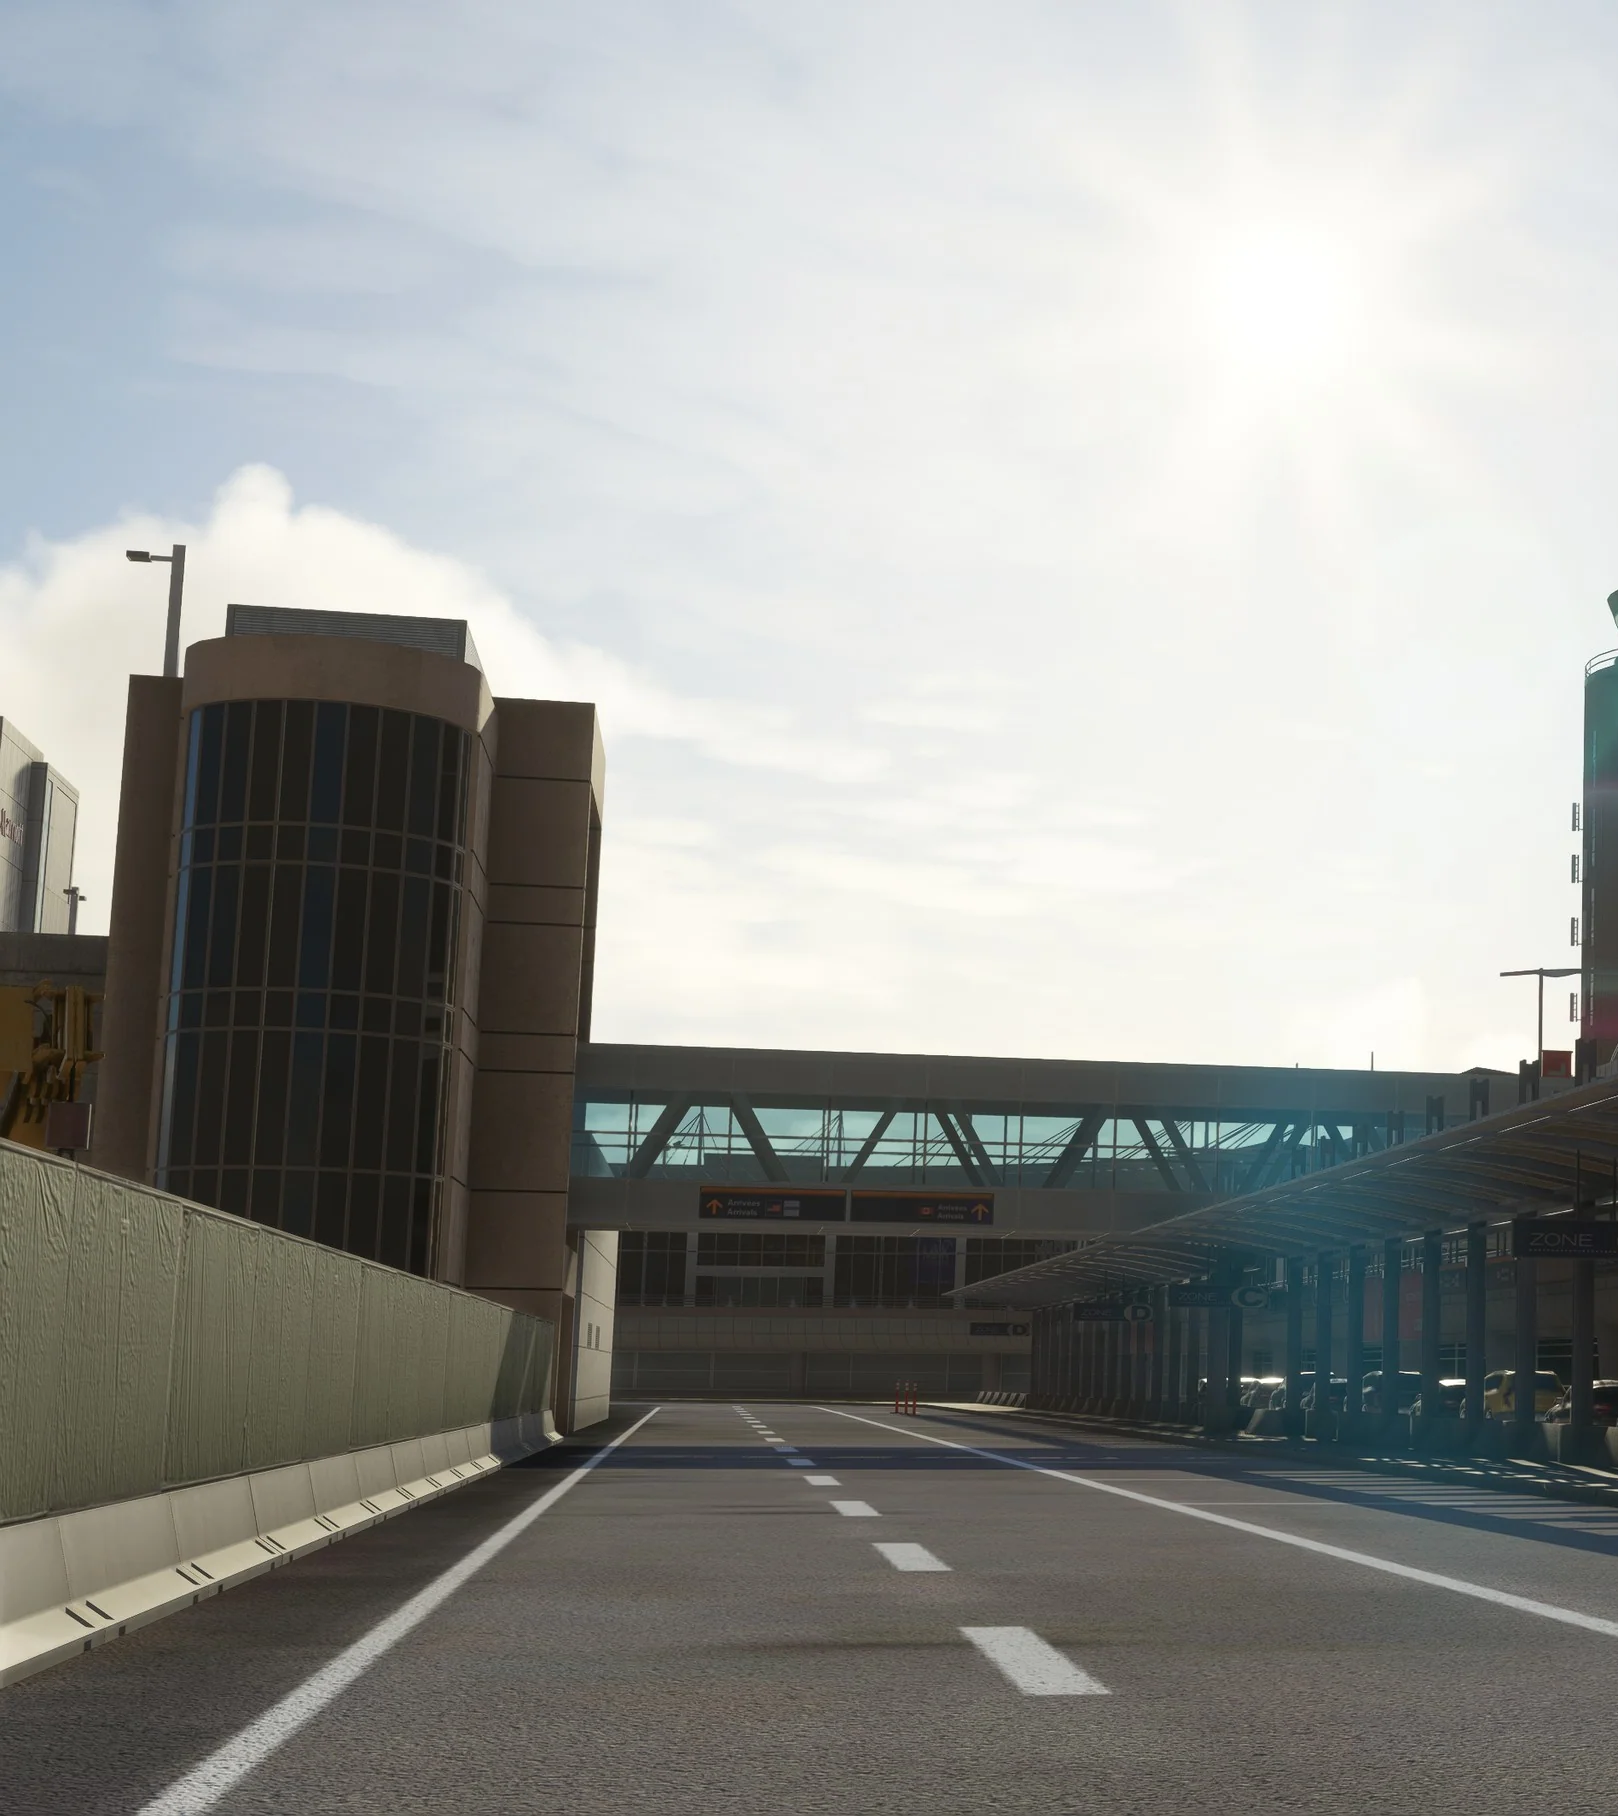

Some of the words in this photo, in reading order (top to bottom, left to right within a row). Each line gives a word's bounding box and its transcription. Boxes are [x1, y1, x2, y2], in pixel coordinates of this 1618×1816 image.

[1529, 1232, 1595, 1247] ZONE
[1177, 1292, 1219, 1302] ZONE
[1238, 1287, 1264, 1306] C
